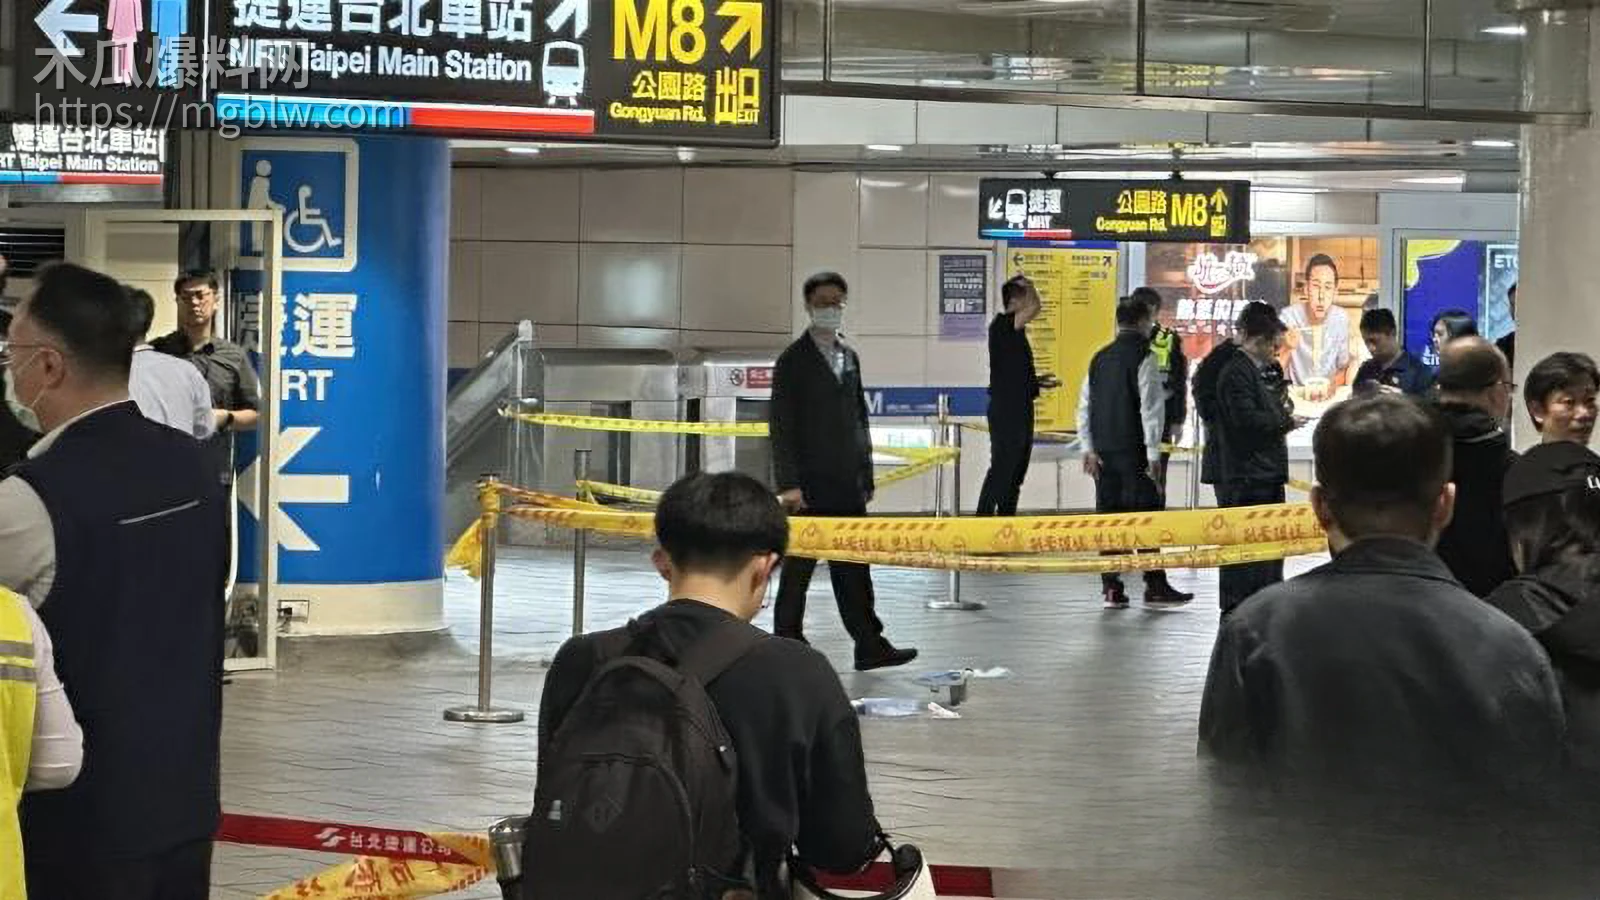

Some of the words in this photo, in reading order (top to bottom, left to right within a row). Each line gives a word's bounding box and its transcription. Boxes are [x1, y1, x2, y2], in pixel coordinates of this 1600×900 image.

[613, 0, 706, 64] M8
[297, 42, 371, 79] Taipei
[378, 46, 439, 77] Main
[445, 49, 532, 81] Station
[632, 69, 706, 101] 公園路
[714, 66, 760, 124] 出口
[610, 102, 681, 122] Gongyuan
[682, 105, 706, 122] Rd.
[20, 155, 63, 171] Taipei
[65, 155, 102, 170] Main
[105, 156, 158, 172] Station
[1171, 193, 1208, 227] M8
